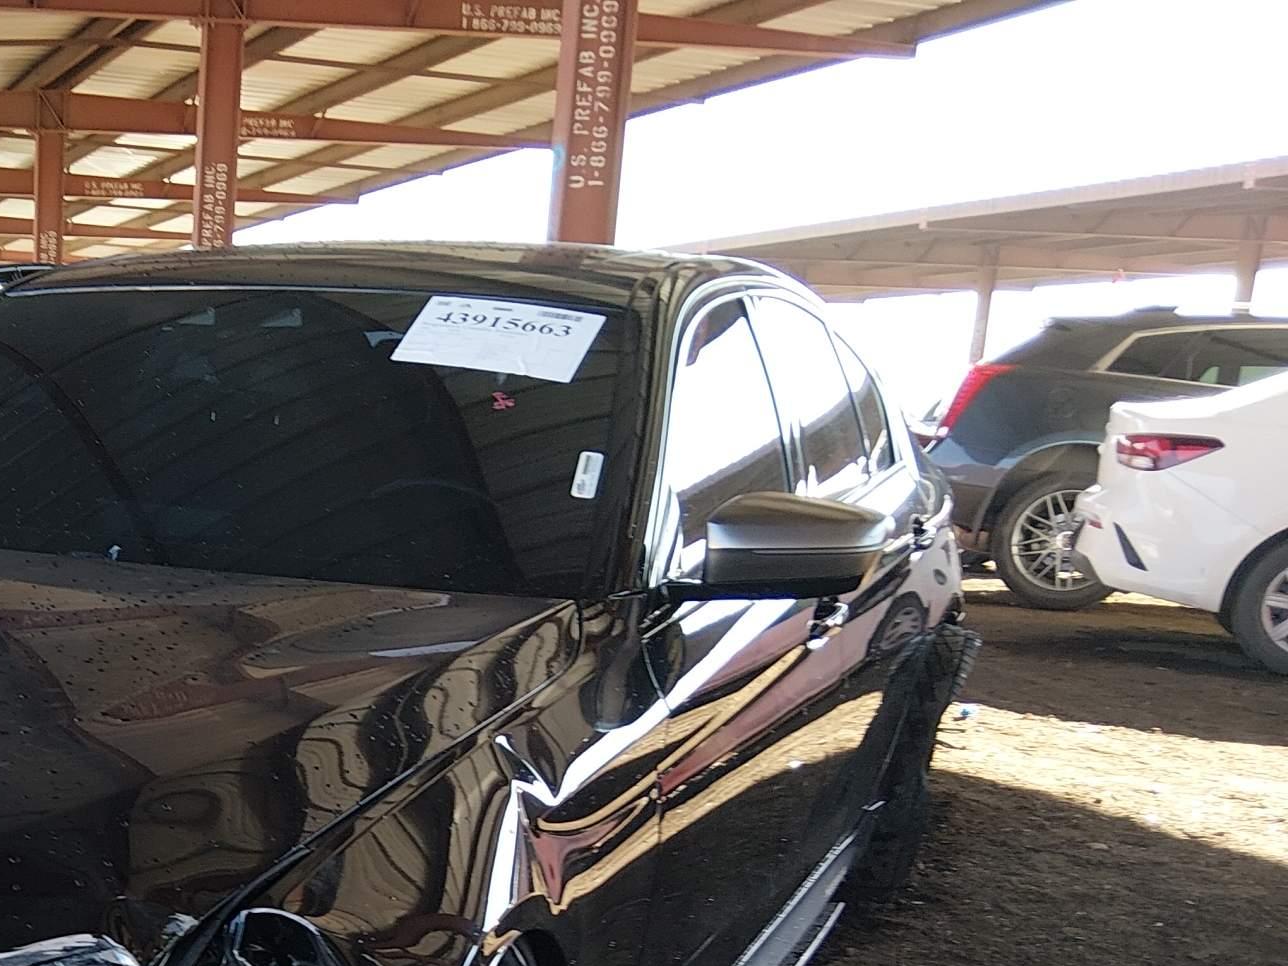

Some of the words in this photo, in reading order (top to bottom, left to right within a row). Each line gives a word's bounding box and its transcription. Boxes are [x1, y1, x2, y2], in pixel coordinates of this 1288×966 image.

[490, 4, 537, 20] PREFAB
[573, 49, 597, 136] PREFAB
[435, 311, 574, 338] 43915663
